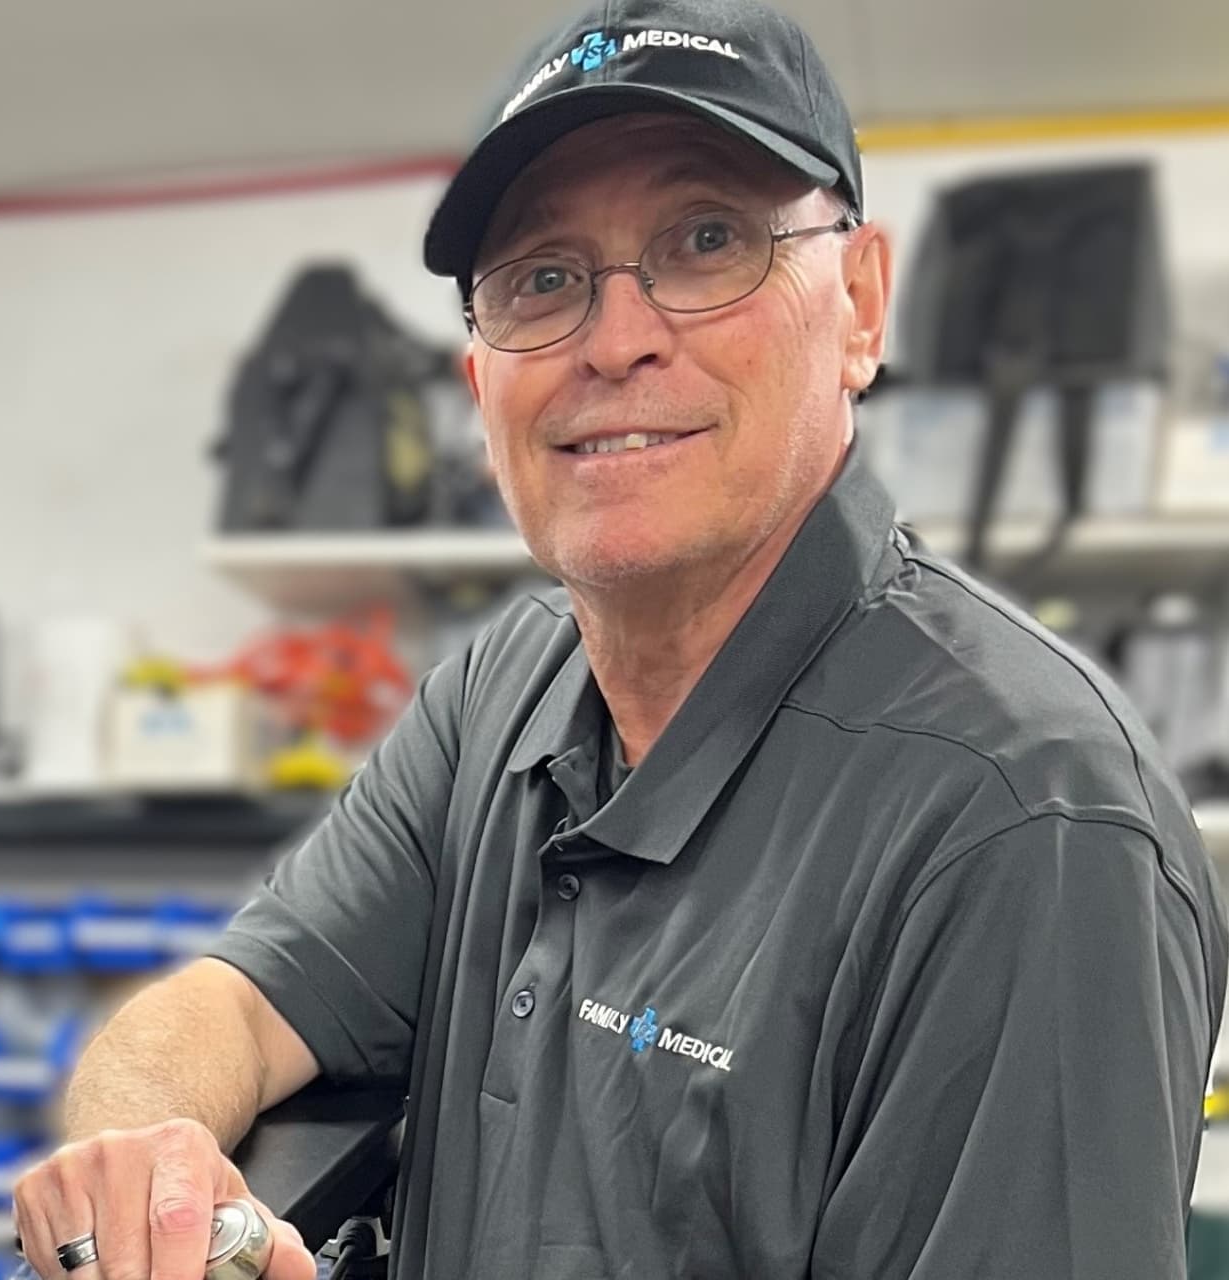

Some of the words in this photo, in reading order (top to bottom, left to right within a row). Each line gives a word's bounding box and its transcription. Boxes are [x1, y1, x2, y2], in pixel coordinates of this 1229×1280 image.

[622, 30, 740, 60] MEDICAL
[578, 998, 630, 1034] FAMILY
[658, 1028, 733, 1072] MEDICAL
